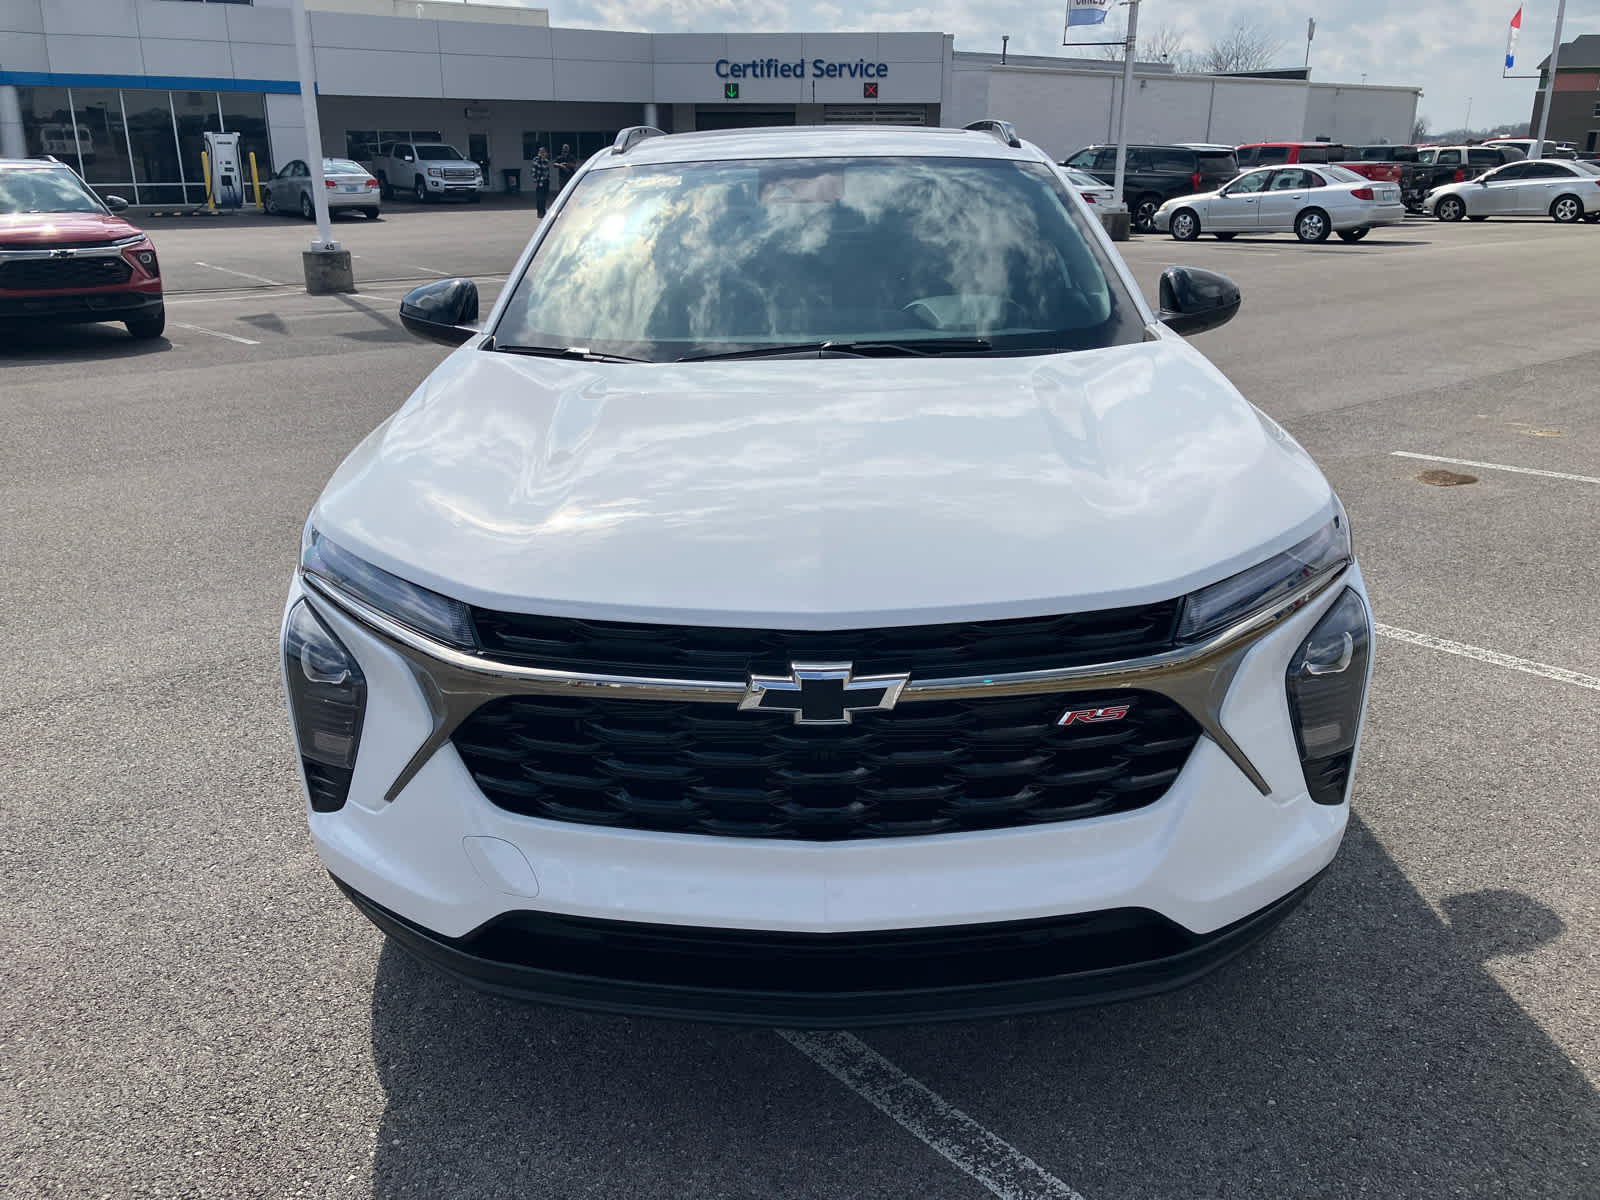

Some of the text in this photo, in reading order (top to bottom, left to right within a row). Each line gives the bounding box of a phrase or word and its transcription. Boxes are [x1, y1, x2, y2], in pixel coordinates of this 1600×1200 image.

[715, 59, 888, 79] Certified Service
[1057, 705, 1130, 725] RS
